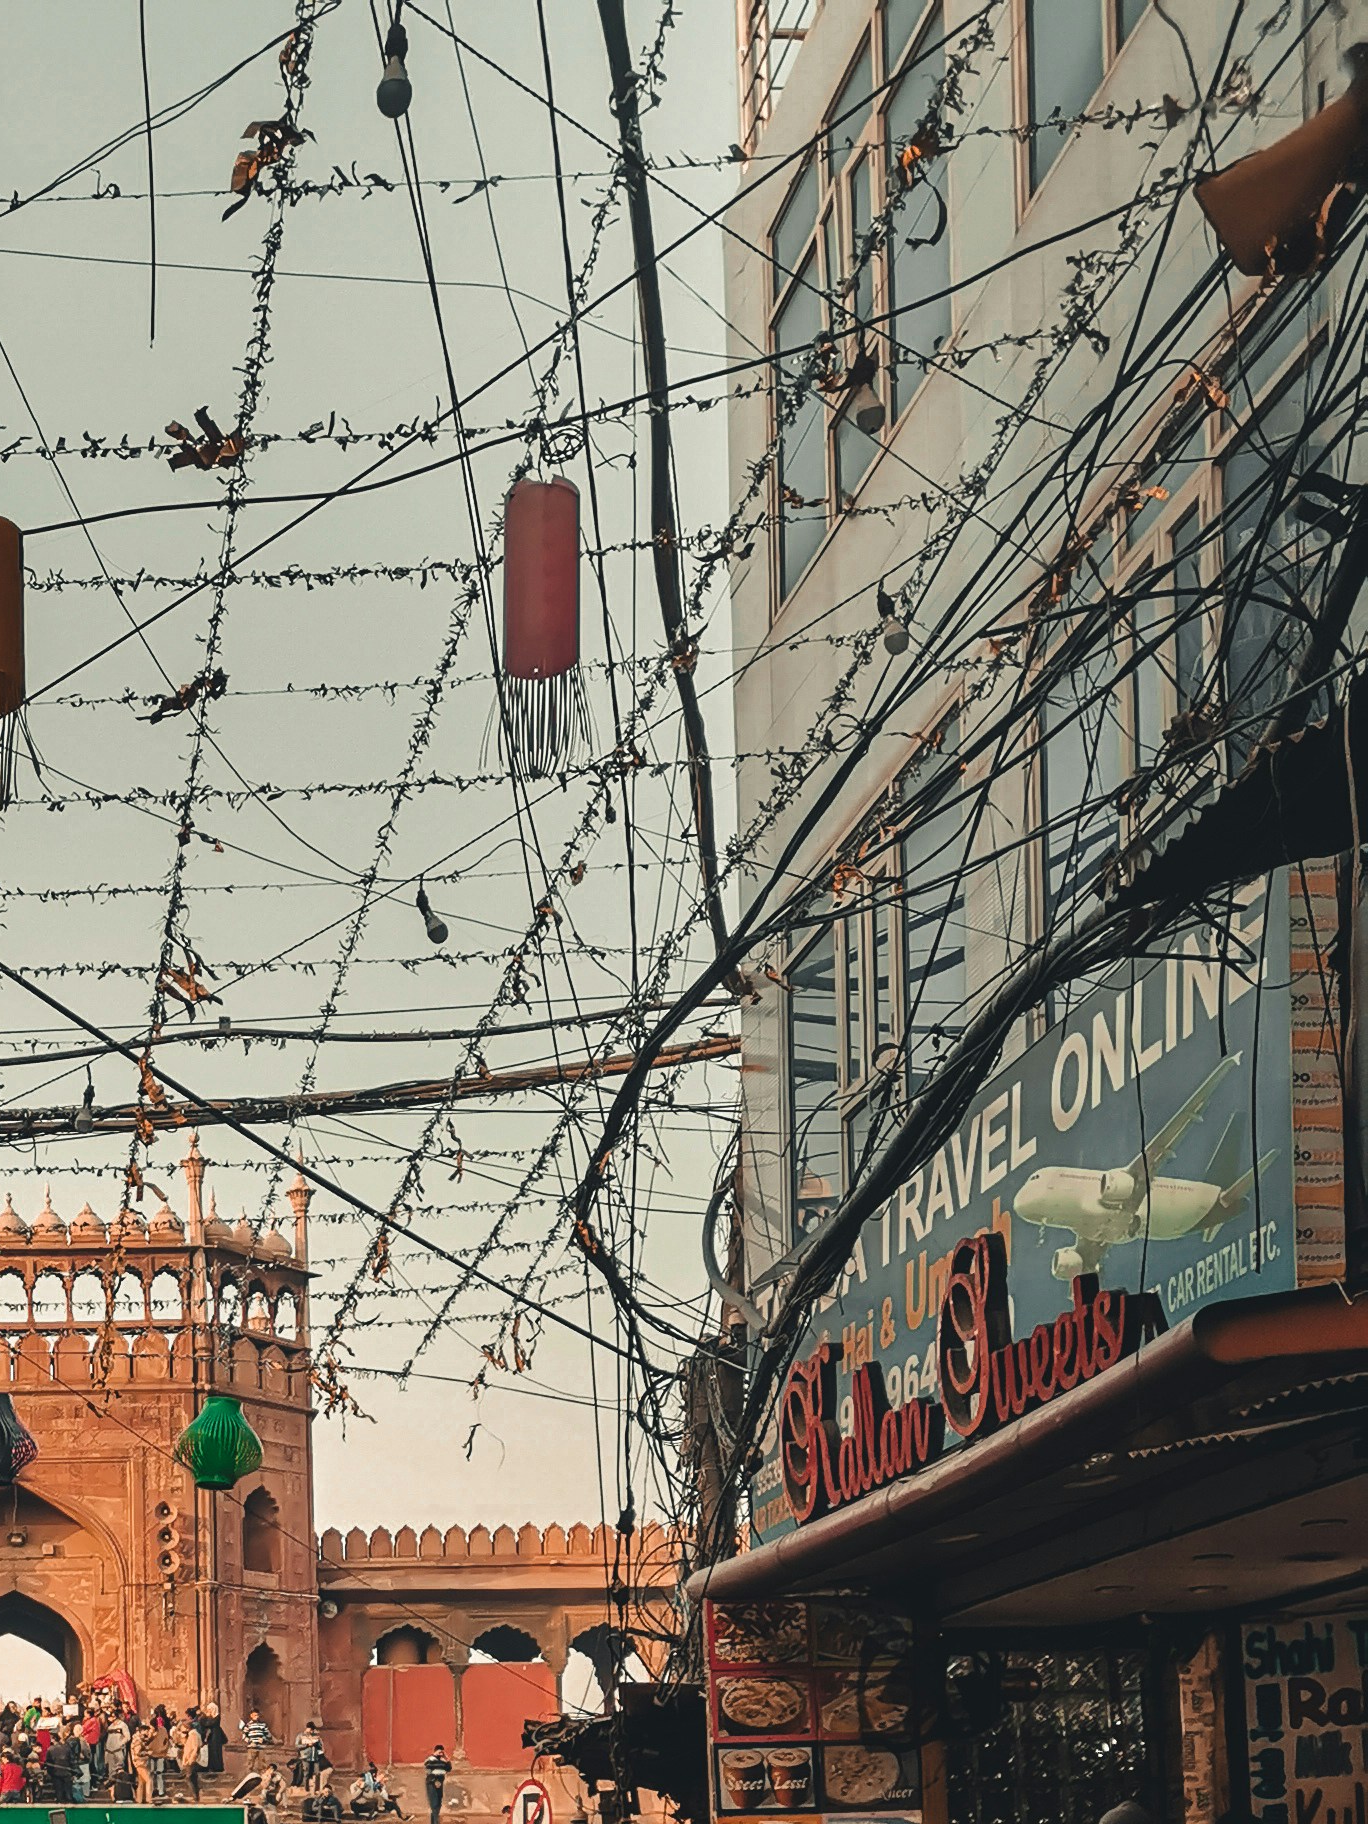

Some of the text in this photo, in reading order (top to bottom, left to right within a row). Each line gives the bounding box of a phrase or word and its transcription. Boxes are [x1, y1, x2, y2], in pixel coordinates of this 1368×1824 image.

[1051, 874, 1268, 1132] ONLINE
[842, 1308, 874, 1375] Haj
[1167, 1220, 1281, 1313] CAR RENTAL ETC.
[782, 1344, 931, 1522] Kallan
[937, 1234, 1126, 1437] Sweets
